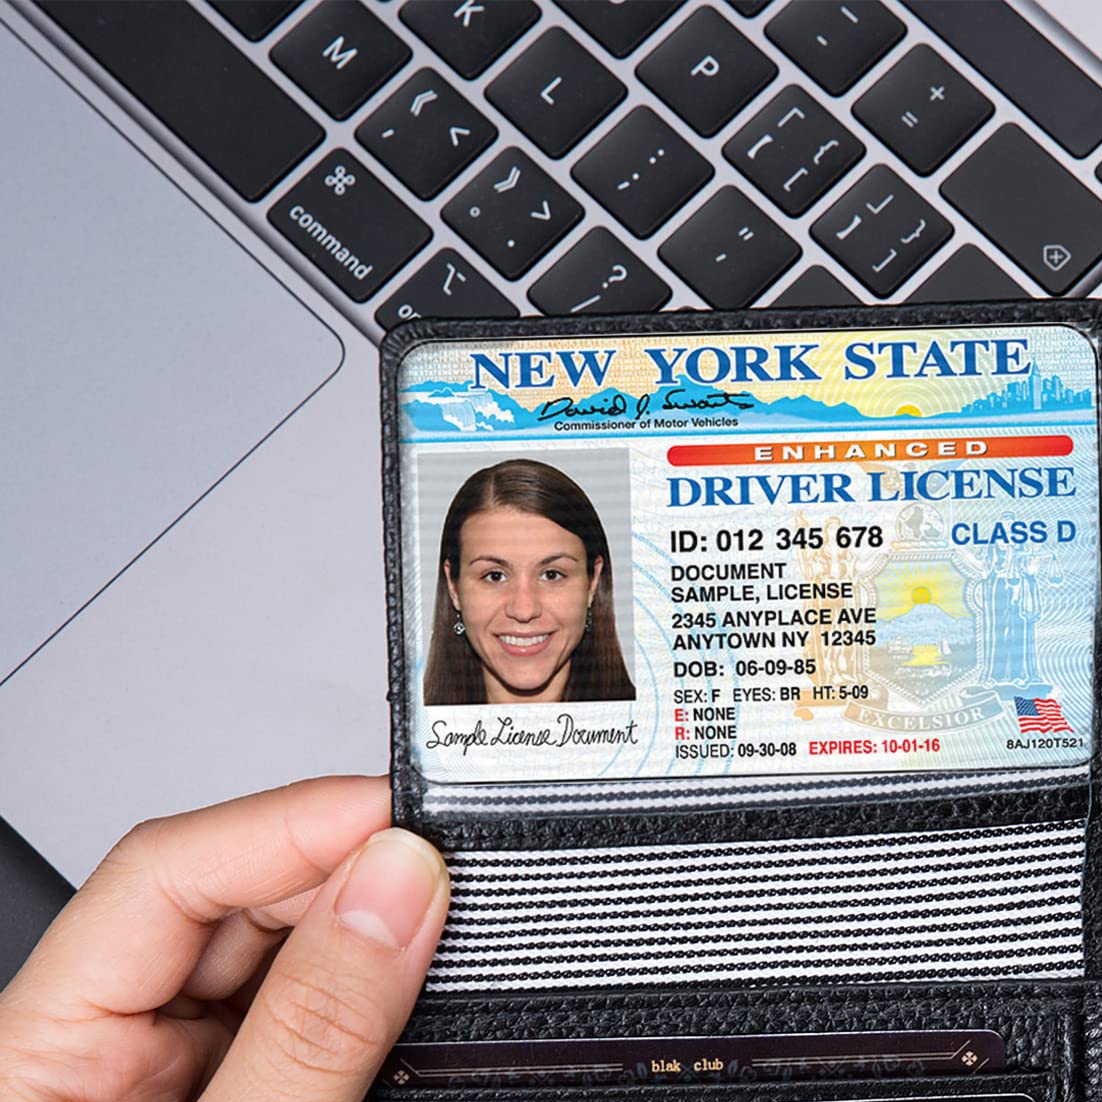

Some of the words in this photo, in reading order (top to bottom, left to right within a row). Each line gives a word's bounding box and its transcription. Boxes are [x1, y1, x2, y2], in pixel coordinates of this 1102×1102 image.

[322, 36, 359, 70] M
[691, 55, 721, 79] P
[540, 76, 563, 105] L
[289, 204, 374, 281] command
[470, 349, 617, 390] NEW
[644, 344, 822, 386] YORK
[844, 338, 1032, 380] STATE
[554, 419, 636, 431] Commissioner
[640, 418, 650, 429] of
[654, 417, 689, 429] Motor
[692, 416, 739, 427] Vehicles
[754, 440, 989, 462] ENHANCED
[666, 472, 857, 507] DRIVER
[867, 467, 1077, 502] LICENSE
[670, 529, 708, 553] ID:
[716, 528, 764, 552] 012
[775, 527, 823, 551] 345
[835, 526, 884, 549] 678
[951, 520, 1048, 545] CLASS
[1056, 520, 1077, 543] D
[670, 562, 787, 582] DOCUMENT
[671, 585, 761, 604] SAMPLE,
[766, 582, 853, 600] LICENSE
[671, 612, 717, 629] 2345
[721, 609, 833, 627] ANYPLACE
[837, 607, 877, 624] AVE
[672, 632, 775, 651] ANYTOWN
[782, 631, 809, 647] NY
[820, 629, 877, 646] 12345
[673, 660, 725, 678] DOB:
[735, 659, 817, 676] 06-09-85
[673, 689, 708, 704] SEX:
[712, 689, 721, 702] F
[733, 687, 776, 702] EYES:
[780, 686, 801, 701] BR
[812, 685, 836, 700] HT:
[838, 685, 869, 700] 5-09
[674, 708, 689, 722] E:
[692, 707, 736, 721] NONE
[855, 706, 986, 731] EXCELSIOR
[425, 719, 489, 756] Sample
[490, 716, 557, 747] License
[556, 713, 639, 748] Document
[675, 726, 690, 740] R:
[694, 725, 737, 740] NONE
[675, 743, 735, 759] ISSUED:
[737, 742, 797, 757] 09-30-08
[808, 740, 878, 756] EXPIRES:
[882, 738, 941, 754] 10-01-16
[693, 1058, 724, 1072] club
